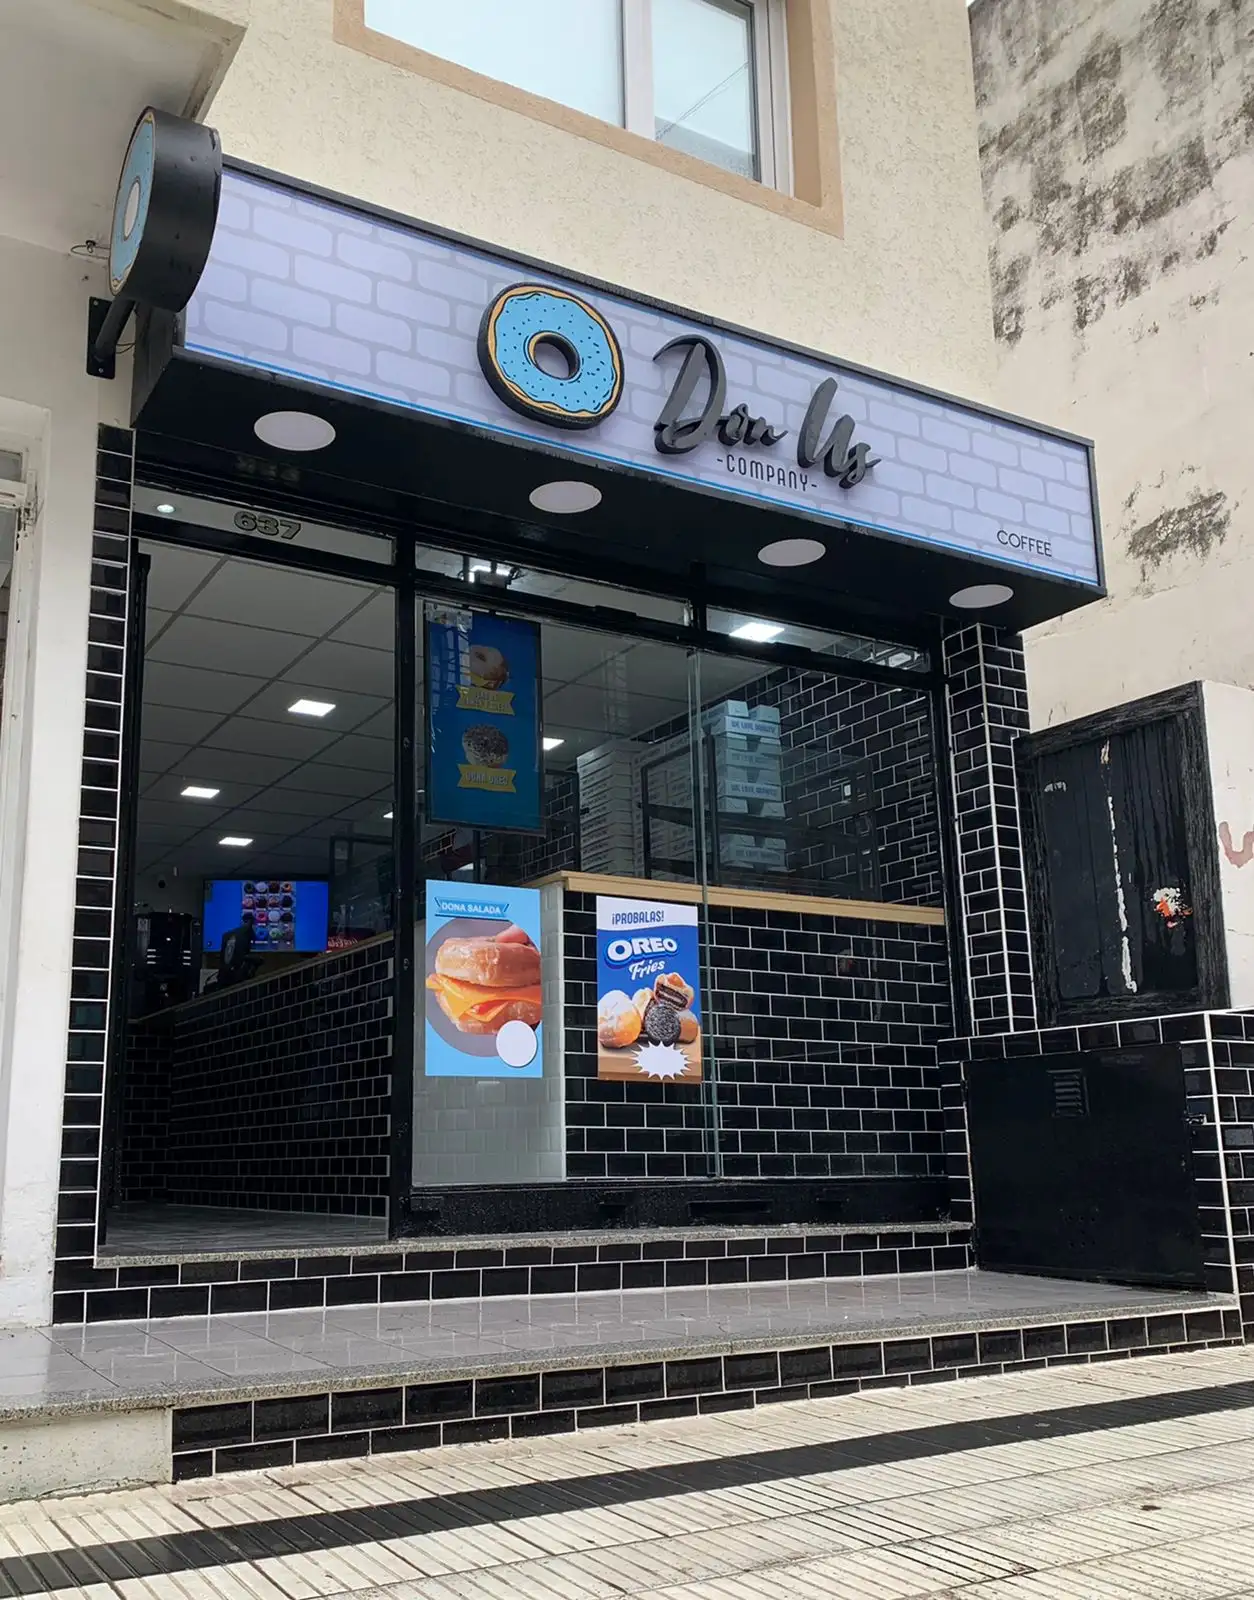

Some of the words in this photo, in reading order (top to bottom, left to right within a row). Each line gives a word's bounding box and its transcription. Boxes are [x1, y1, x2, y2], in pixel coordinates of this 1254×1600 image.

[653, 334, 788, 454] Don
[234, 511, 301, 539] 637
[996, 529, 1052, 557] COFFEE
[441, 902, 466, 911] DONA
[467, 904, 502, 914] SALADA
[612, 910, 664, 925] ¡PROBALAS!
[607, 937, 678, 962] OREO
[628, 959, 666, 981] Fries
